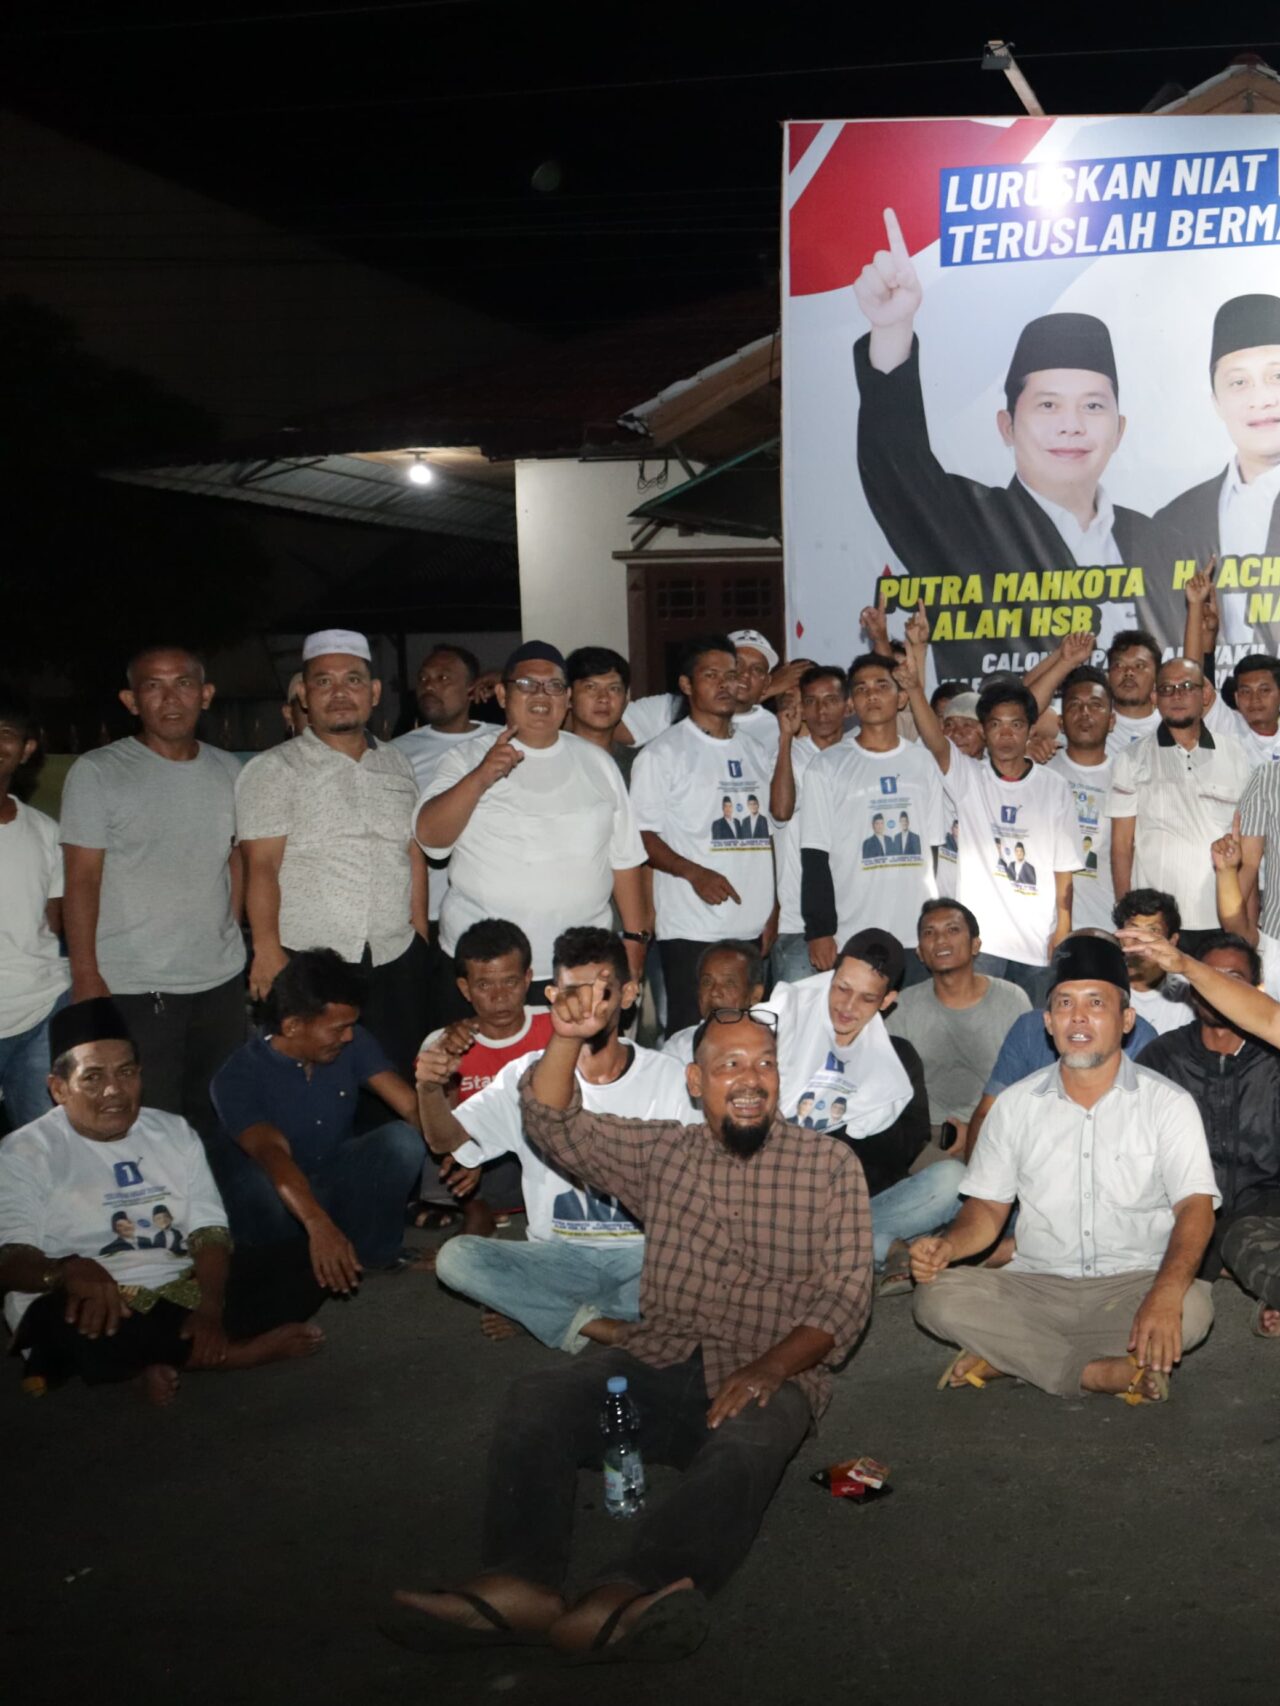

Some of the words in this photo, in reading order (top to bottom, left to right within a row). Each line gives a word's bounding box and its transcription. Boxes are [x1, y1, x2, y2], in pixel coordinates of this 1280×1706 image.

[1171, 154, 1268, 196] NIAT
[948, 211, 1157, 264] TERUSLAH
[879, 573, 984, 609] PUTRA
[991, 567, 1146, 603] MAHKOTA
[930, 608, 1023, 642] ALAM
[1028, 605, 1094, 638] HSB
[460, 1075, 498, 1092] Sta
[122, 1164, 135, 1183] 1
